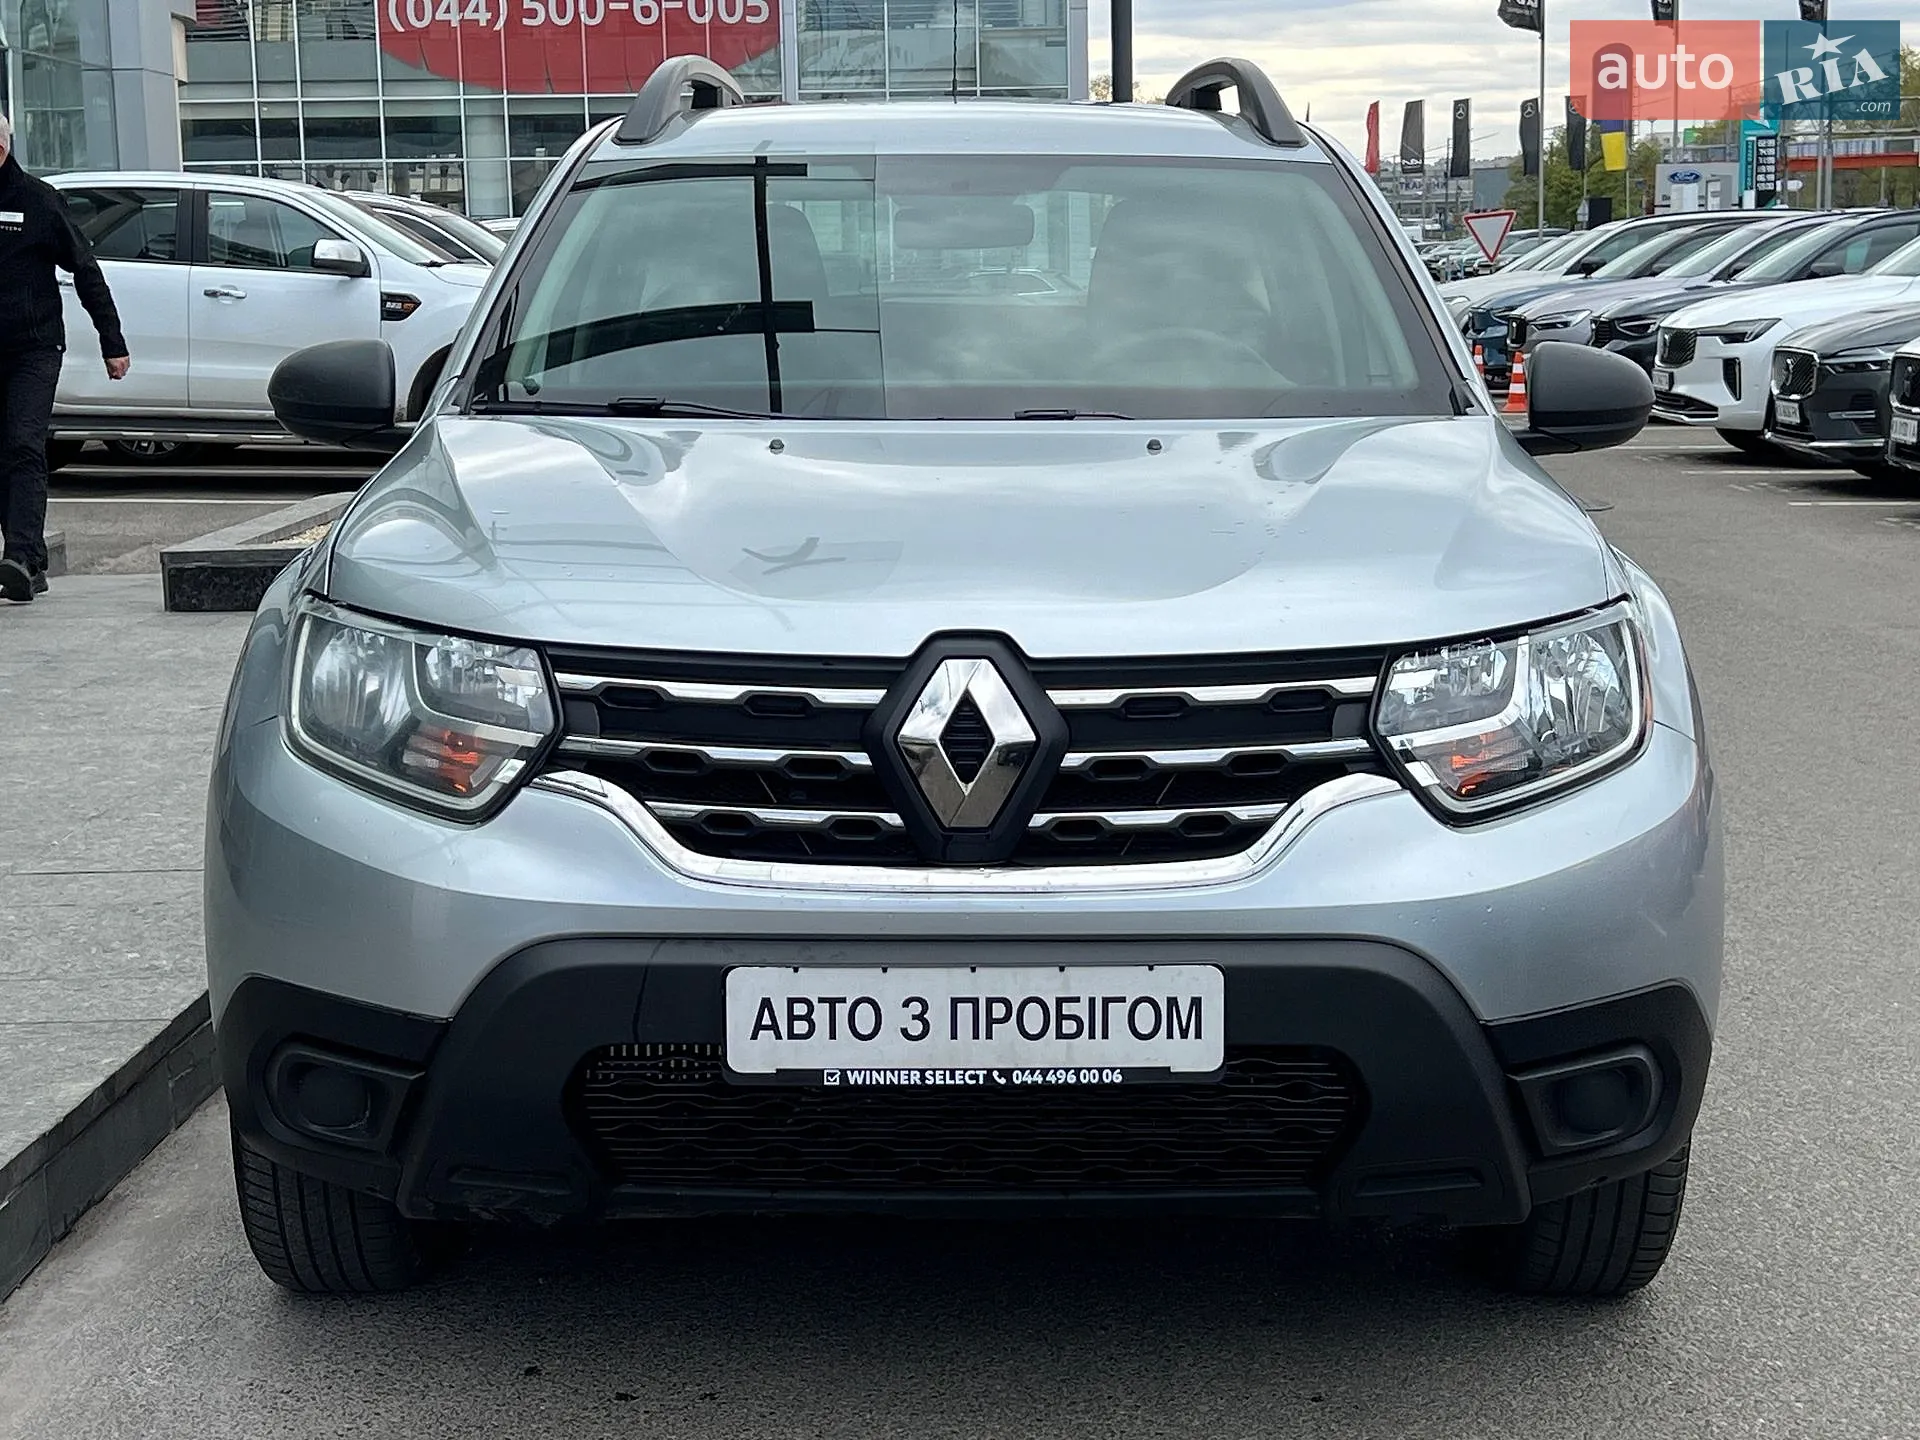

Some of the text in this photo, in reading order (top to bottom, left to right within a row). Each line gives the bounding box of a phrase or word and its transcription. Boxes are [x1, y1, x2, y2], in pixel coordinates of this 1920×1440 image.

[388, 0, 770, 32] (044) 500-6-005
[749, 996, 1203, 1041] АВТО З ПРОБІГОМ
[846, 1068, 1123, 1085] WINNER SELECT 044 496 00 06
